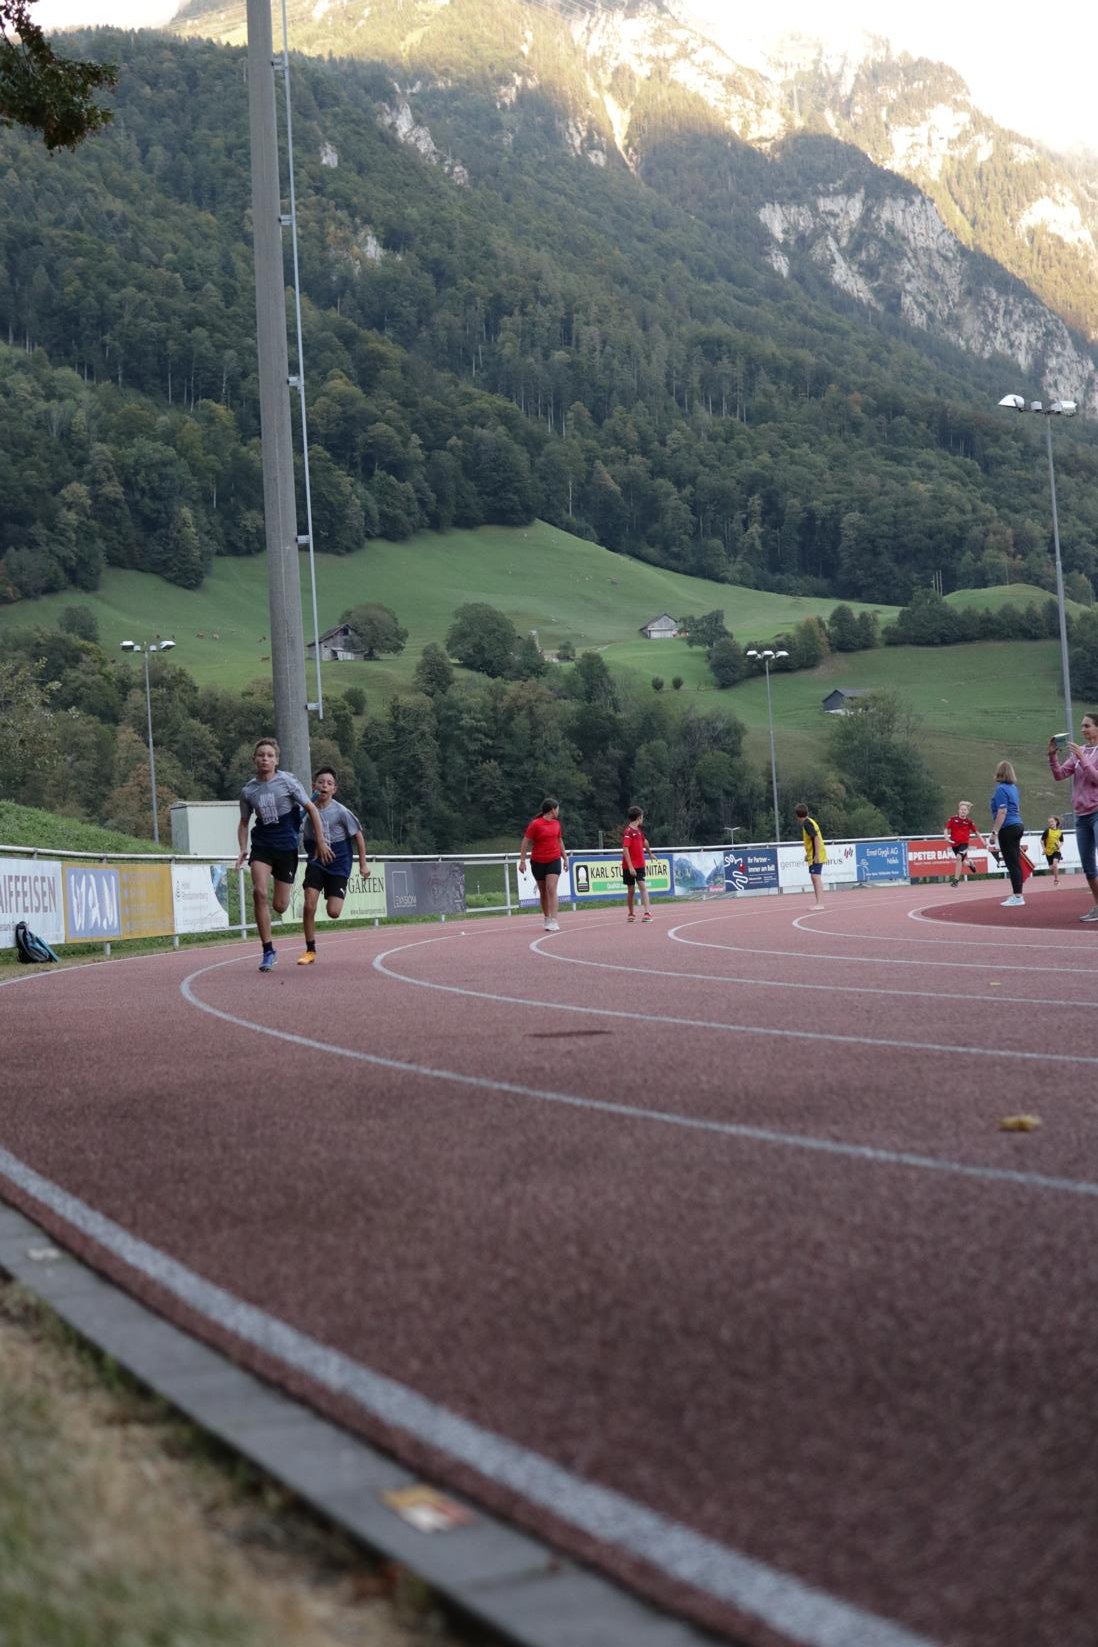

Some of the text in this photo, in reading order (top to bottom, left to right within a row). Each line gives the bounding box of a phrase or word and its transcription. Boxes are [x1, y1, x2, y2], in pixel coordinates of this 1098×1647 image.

[890, 847, 898, 855] AG
[913, 850, 936, 861] PETER
[590, 866, 609, 878] KARL
[646, 862, 667, 876] NITÄR
